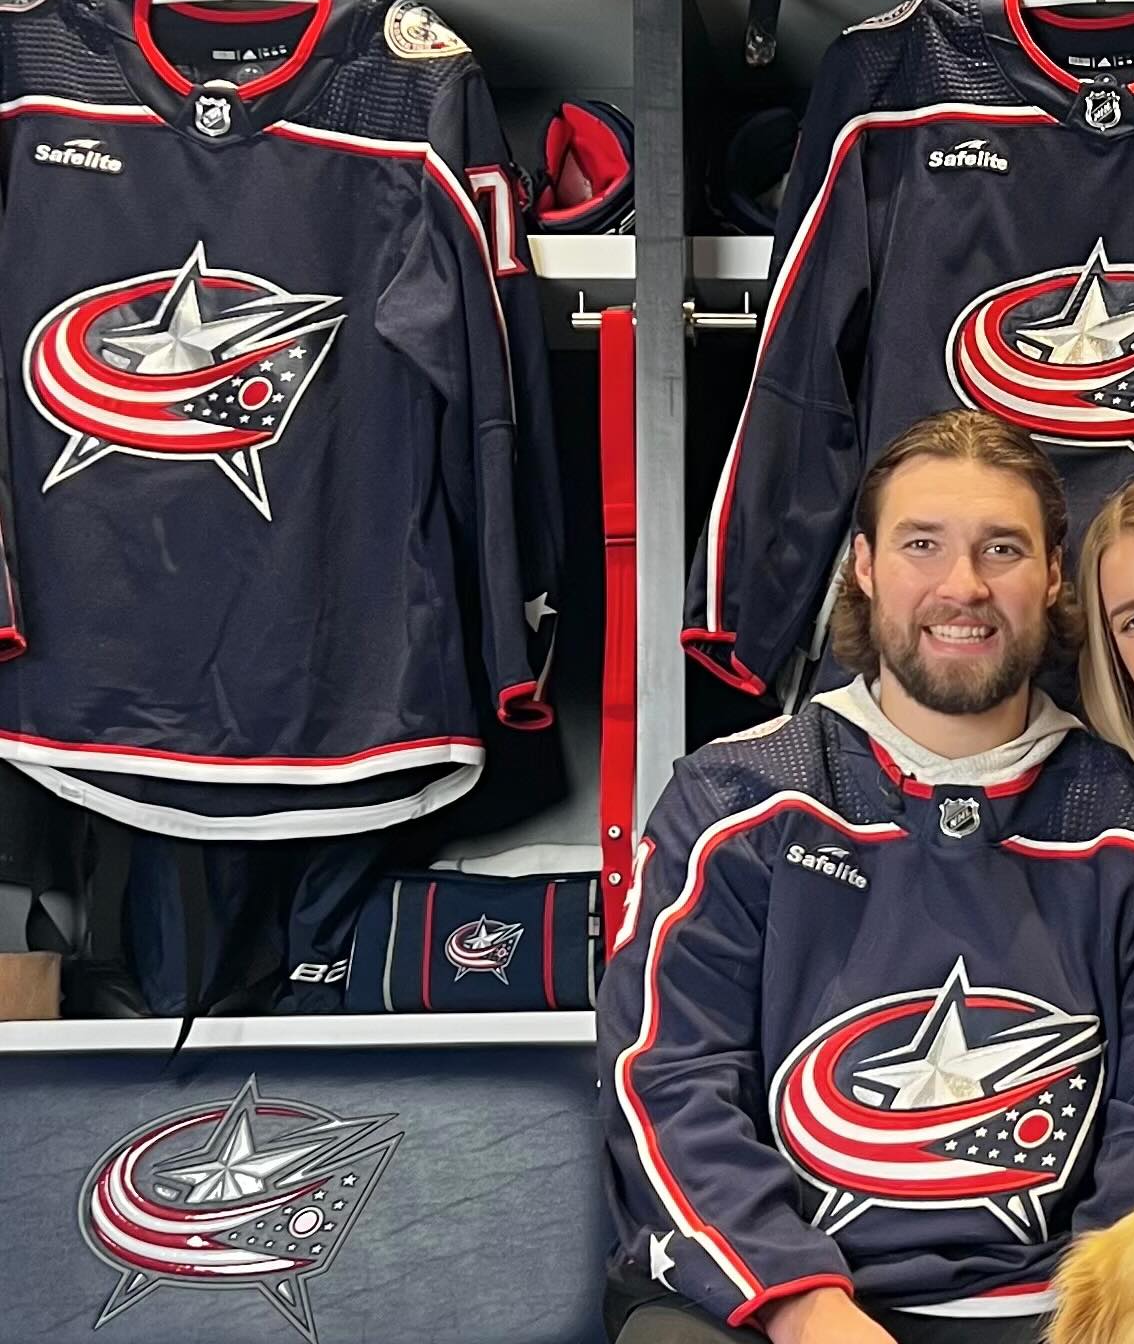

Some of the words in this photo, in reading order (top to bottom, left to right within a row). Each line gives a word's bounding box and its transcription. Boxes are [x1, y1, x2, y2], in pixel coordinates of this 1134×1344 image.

[34, 144, 122, 172] Safelite
[928, 150, 1009, 171] Safelite
[786, 844, 868, 889] Safelite
